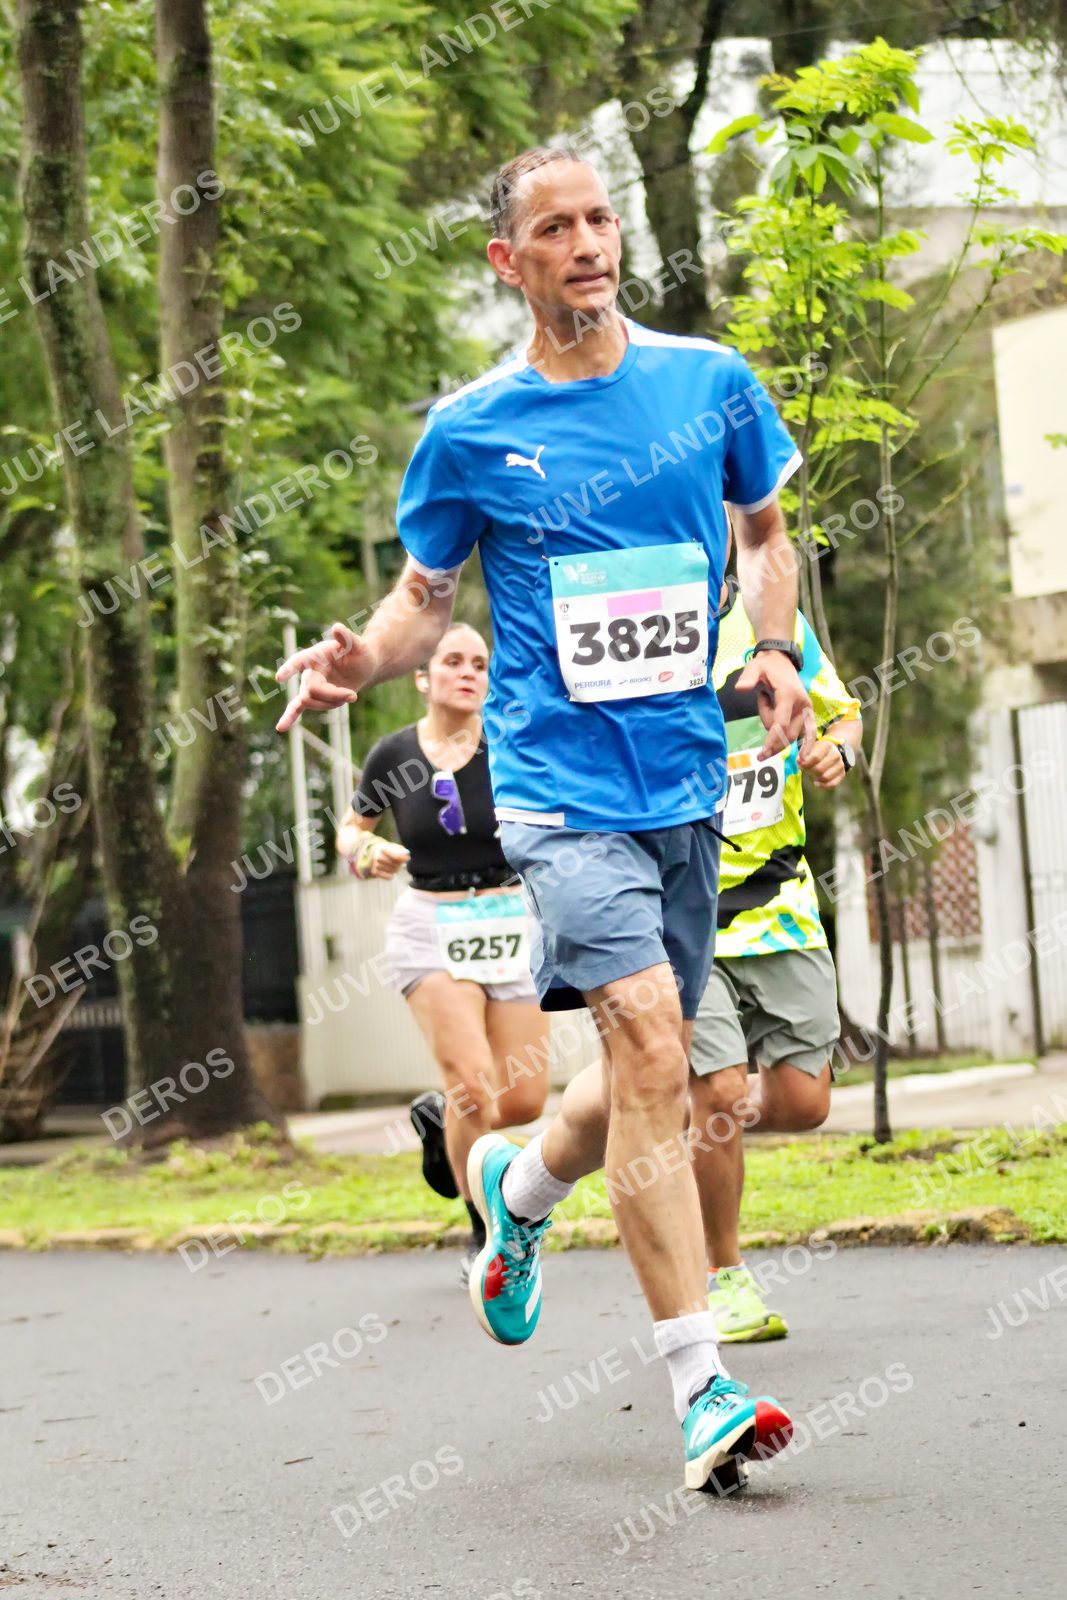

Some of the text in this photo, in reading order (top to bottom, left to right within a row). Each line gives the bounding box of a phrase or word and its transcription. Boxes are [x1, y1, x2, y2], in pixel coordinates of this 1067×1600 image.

[570, 610, 700, 666] 3825
[574, 679, 612, 689] PERDURA
[448, 934, 522, 962] 6257
